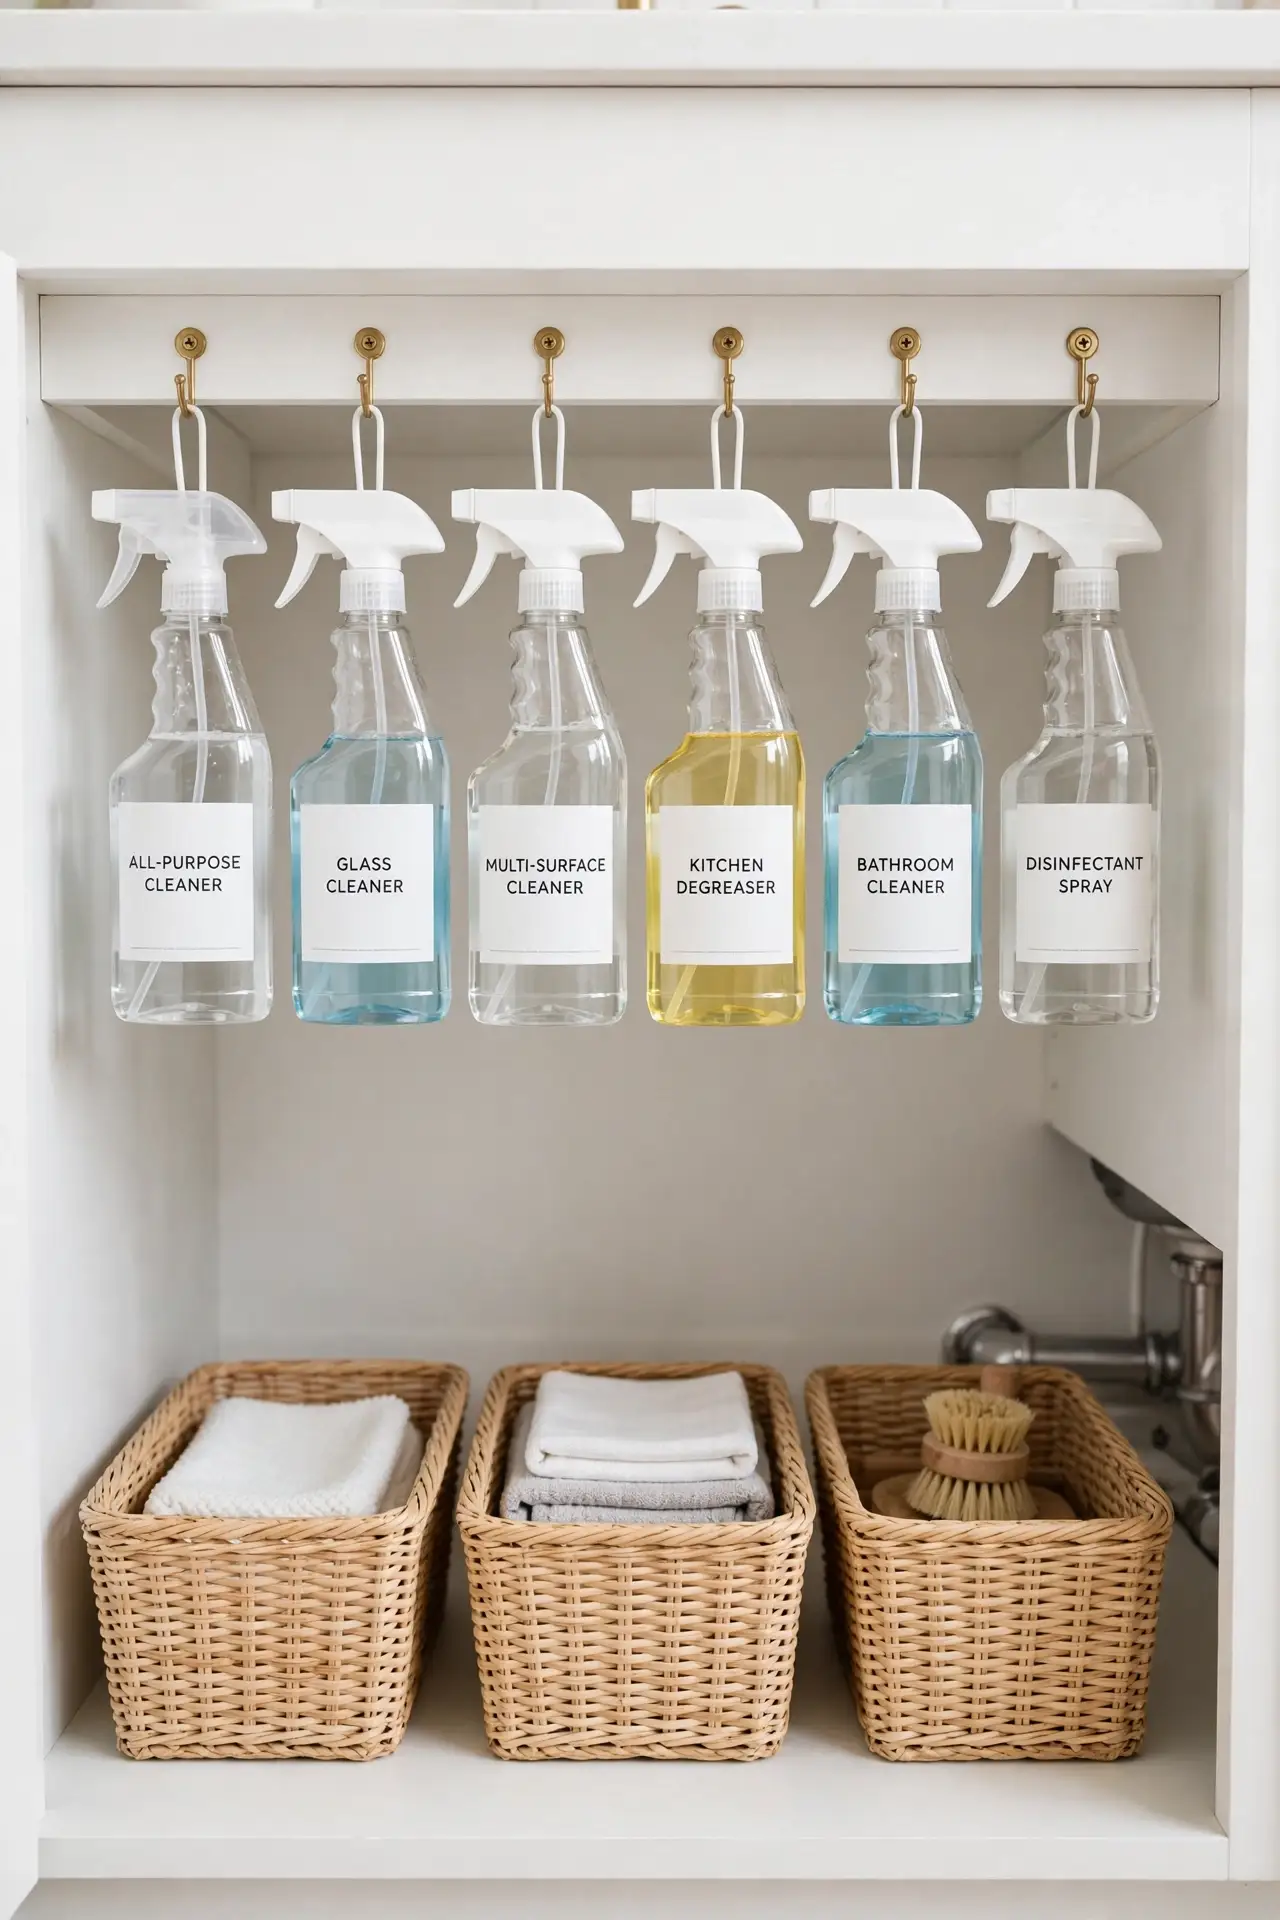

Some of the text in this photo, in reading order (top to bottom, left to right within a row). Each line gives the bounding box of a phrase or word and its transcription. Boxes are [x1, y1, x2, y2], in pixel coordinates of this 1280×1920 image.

[128, 855, 241, 870] ALL-PURPOSE
[336, 856, 392, 872] GLASS
[485, 857, 606, 873] MULTI-SURFACE
[689, 857, 763, 873] KITCHEN
[857, 857, 954, 872] BATHROOM
[1026, 856, 1144, 872] DISINFECTANT
[144, 877, 223, 892] CLEANER
[326, 878, 404, 894] CLEANER
[506, 879, 584, 895] CLEANER
[676, 880, 776, 895] DEGREASER
[866, 879, 945, 894] CLEANER
[1058, 878, 1113, 894] SPRAY
